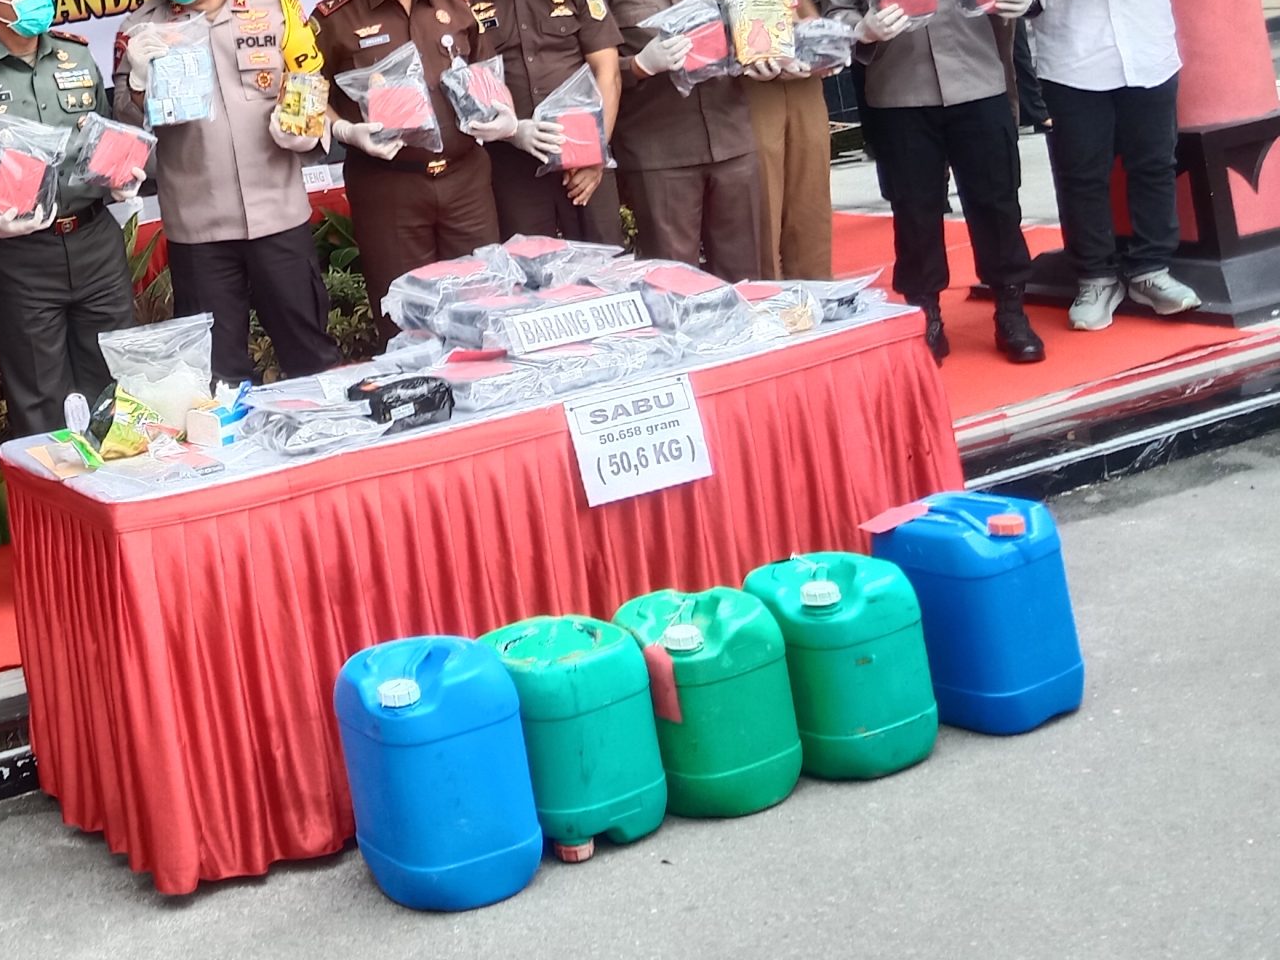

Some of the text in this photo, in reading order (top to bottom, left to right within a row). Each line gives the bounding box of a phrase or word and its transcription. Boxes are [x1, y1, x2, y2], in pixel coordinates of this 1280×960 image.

[236, 35, 277, 49] POLRI
[519, 298, 644, 345] BARANG BUKTI
[589, 392, 675, 426] SABU
[599, 418, 680, 445] 50.658 gram
